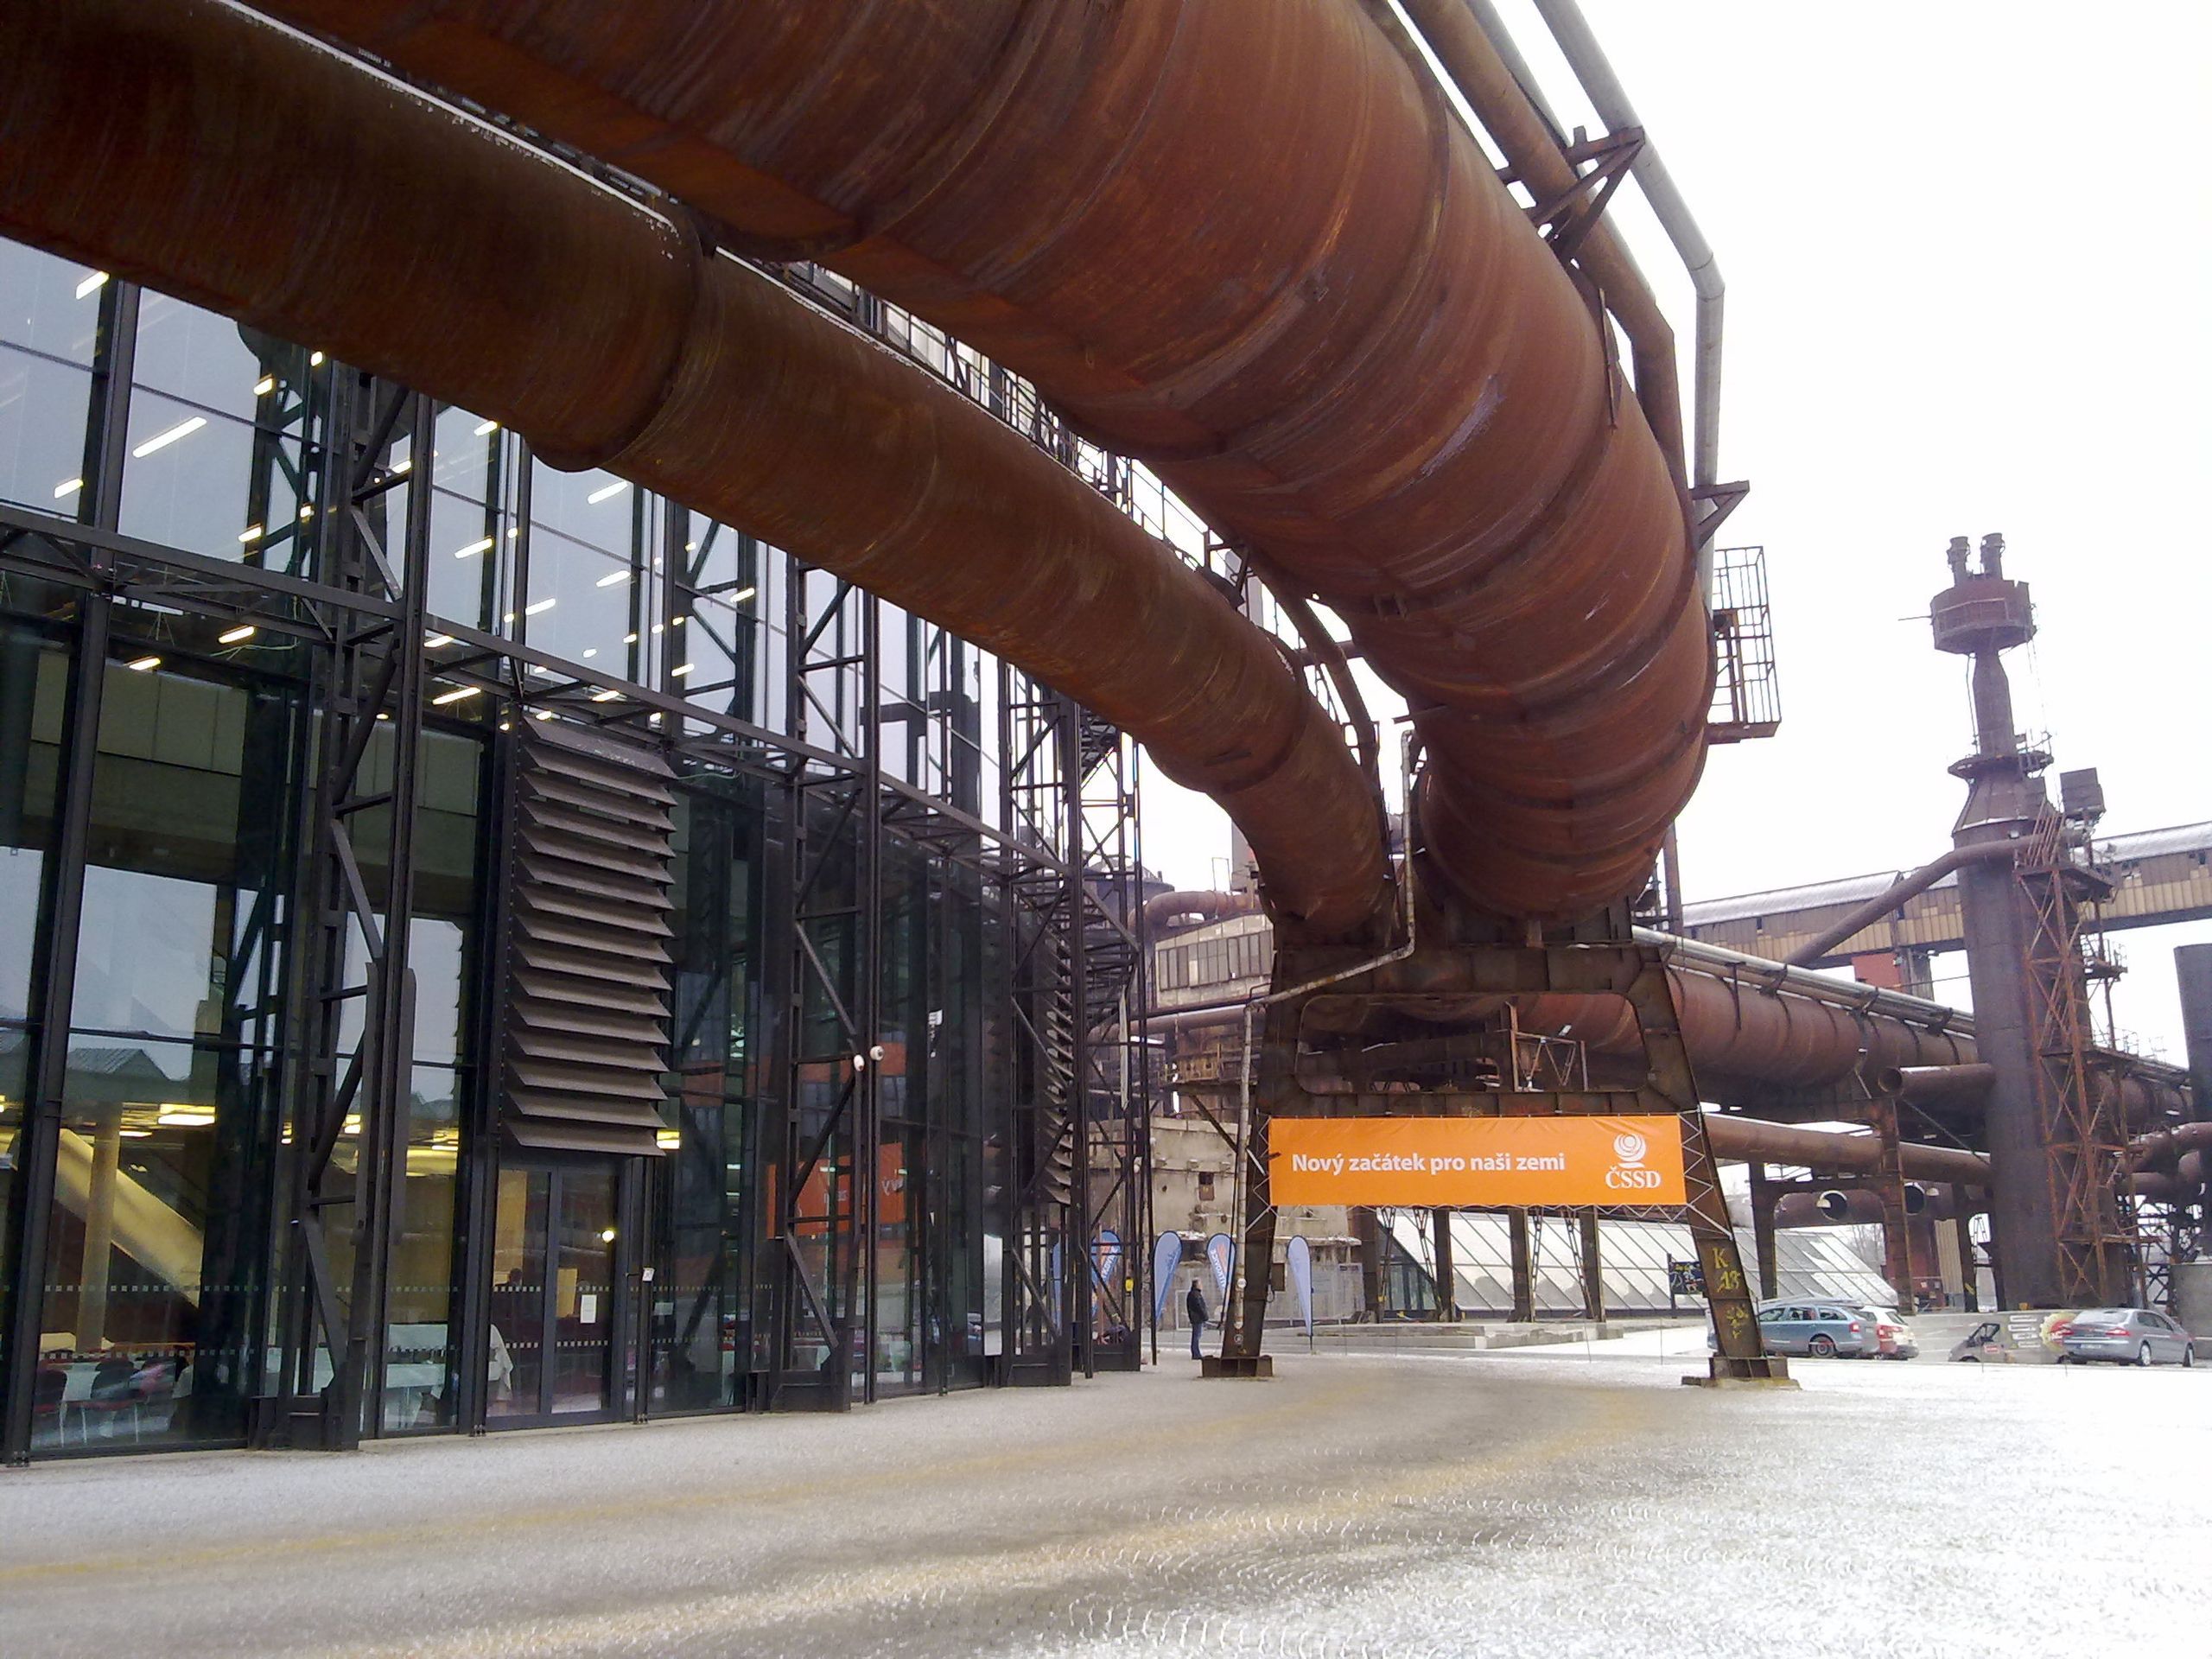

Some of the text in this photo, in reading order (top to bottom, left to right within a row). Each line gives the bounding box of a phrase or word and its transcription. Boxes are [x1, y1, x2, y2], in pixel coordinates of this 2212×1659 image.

[1292, 1152, 1566, 1176] Nový začátek pro naši zemi
[1605, 1166, 1662, 1189] ČSSD
[1713, 1247, 1729, 1269] K
